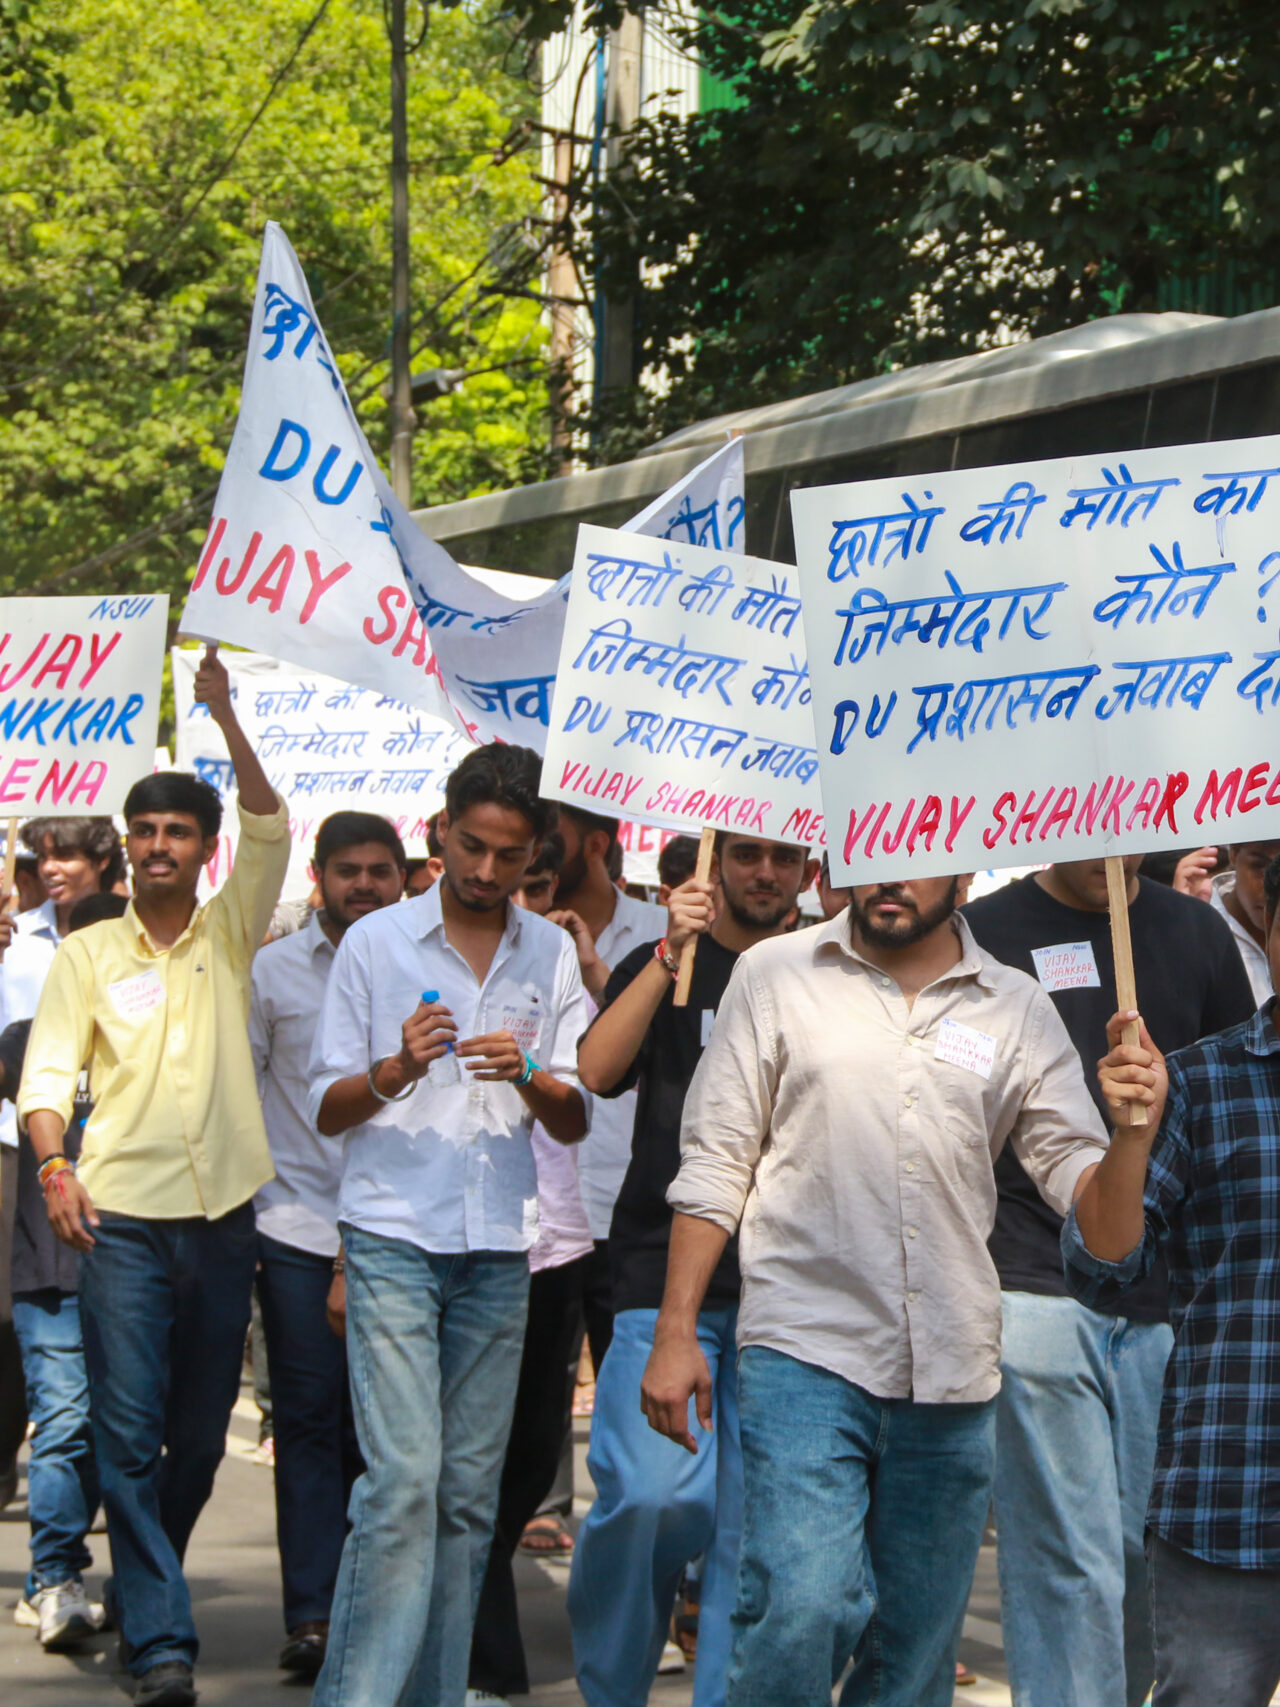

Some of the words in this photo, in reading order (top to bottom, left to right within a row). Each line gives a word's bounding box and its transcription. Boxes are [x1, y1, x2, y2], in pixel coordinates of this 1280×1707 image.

[259, 418, 364, 505] DU
[827, 490, 946, 583] छात्रों
[960, 481, 1047, 546] की
[1060, 463, 1182, 531] मौत
[191, 516, 353, 625] IJAY
[587, 551, 683, 607] छात्रों
[679, 565, 735, 616] की
[732, 574, 801, 638] मौत
[1093, 541, 1236, 629] कौन
[88, 597, 155, 620] NSUI
[455, 674, 556, 727] जव
[829, 690, 897, 755] DU
[906, 664, 1101, 754] प्रशासन
[1095, 651, 1233, 720] जवाब
[382, 717, 444, 757] कौन
[563, 696, 612, 733] DU
[613, 710, 748, 768] प्रशासन
[741, 736, 820, 785] जवाब
[0, 756, 109, 807] ENA
[288, 768, 374, 798] प्रशासन
[369, 768, 434, 795] जवाब
[559, 760, 644, 806] VIJAY
[646, 781, 773, 833] SHANKAR
[843, 795, 976, 866] VIJAY
[982, 769, 1190, 850] SHANKAR
[1045, 952, 1077, 968] VIJAY
[1053, 976, 1088, 991] MEENA
[504, 1016, 537, 1030] VIJAY
[945, 1030, 978, 1049] VIJAY
[943, 1053, 976, 1071] MEENA
